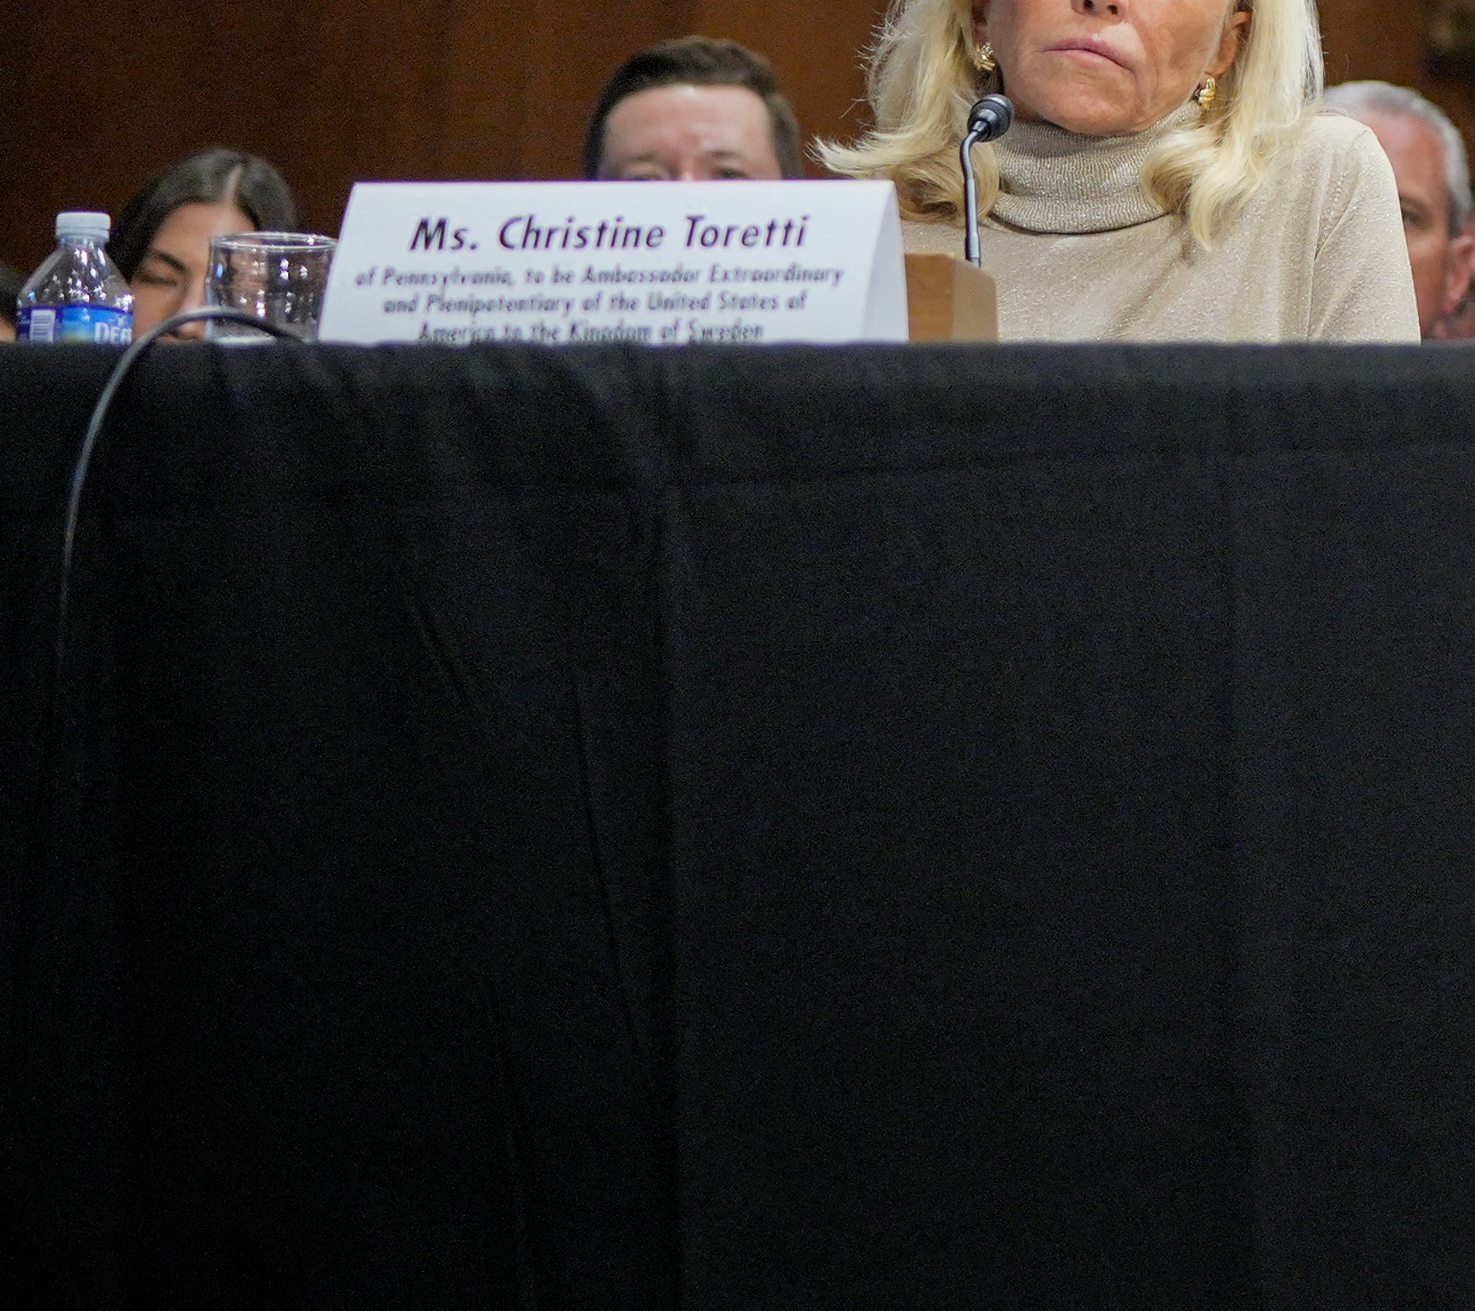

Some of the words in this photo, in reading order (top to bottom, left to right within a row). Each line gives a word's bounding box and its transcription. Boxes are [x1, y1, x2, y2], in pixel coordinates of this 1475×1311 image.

[409, 217, 478, 251] Ms.
[499, 214, 665, 250] Christine
[685, 214, 811, 249] Toretti
[355, 266, 377, 286] of
[525, 266, 545, 284] to
[552, 265, 574, 284] be
[584, 263, 701, 284] Ambassador
[709, 262, 844, 288] Extraordinary
[382, 294, 418, 314] and
[426, 292, 574, 318] Plenipotentiary
[582, 290, 603, 312] of
[610, 290, 640, 312] the
[648, 290, 713, 311] United
[718, 289, 780, 311] States
[787, 289, 809, 310] of
[660, 317, 682, 341] of
